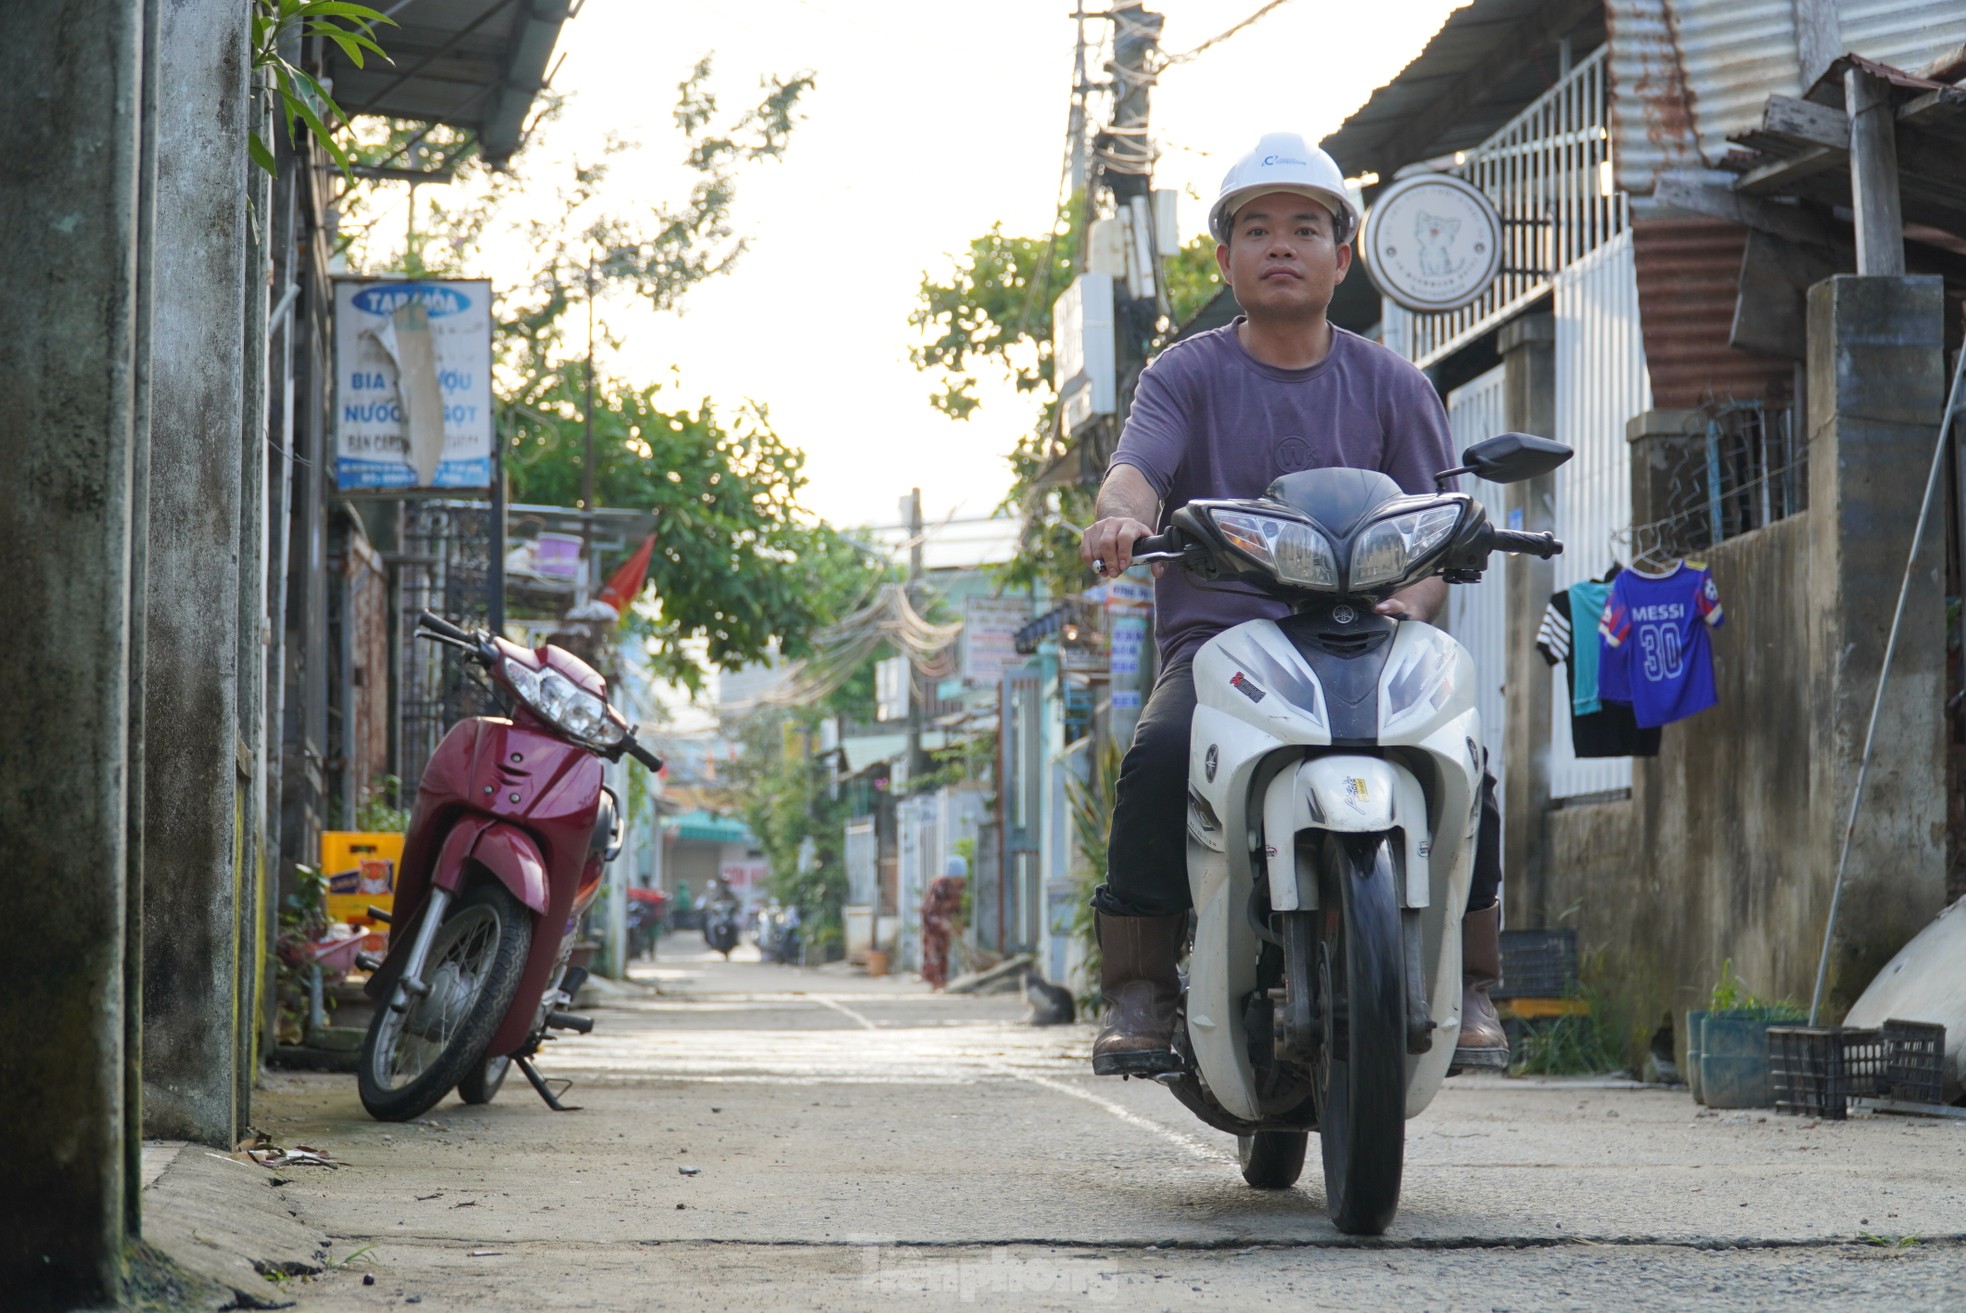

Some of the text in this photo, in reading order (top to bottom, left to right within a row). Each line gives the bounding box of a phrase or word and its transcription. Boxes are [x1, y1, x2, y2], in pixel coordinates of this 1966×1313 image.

[351, 371, 385, 391] BIA
[1632, 603, 1684, 622] MESSI
[1640, 622, 1683, 681] 30
